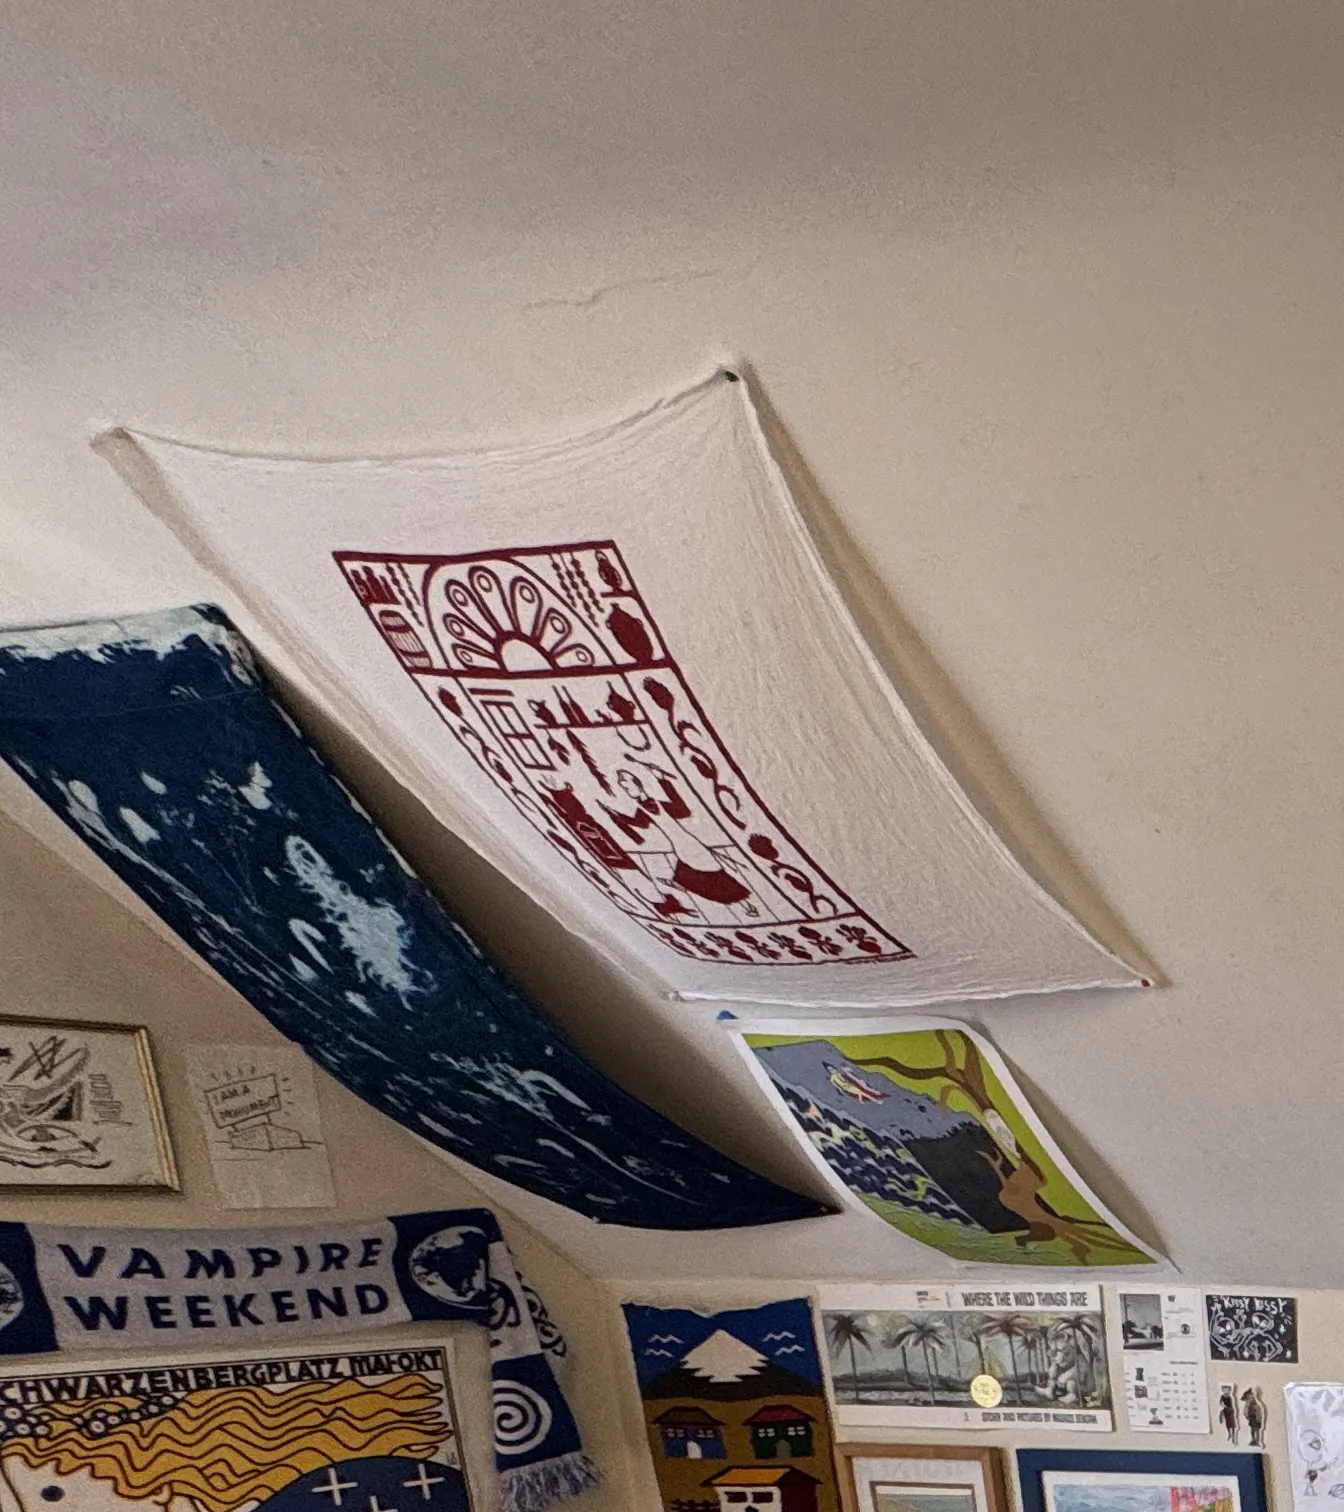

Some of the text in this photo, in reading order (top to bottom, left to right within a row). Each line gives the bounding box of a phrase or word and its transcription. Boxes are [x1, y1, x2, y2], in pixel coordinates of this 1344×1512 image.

[56, 1237, 384, 1280] VAMPIRE
[63, 1283, 390, 1331] WEEKEND
[0, 1357, 343, 1403] CHWARZENBERGPLATZ
